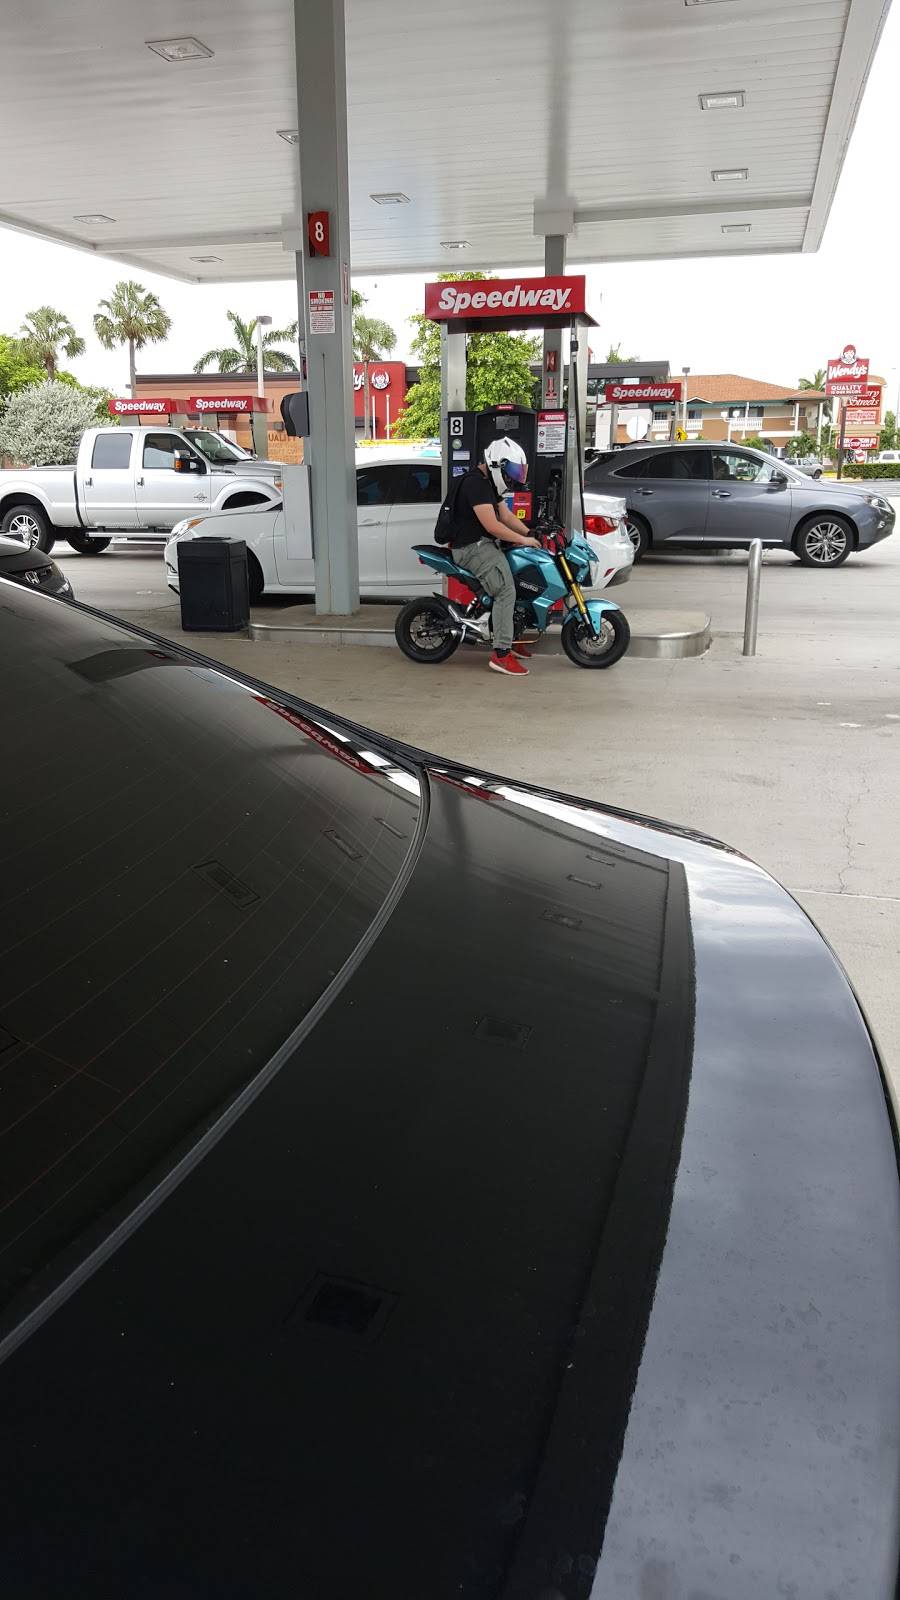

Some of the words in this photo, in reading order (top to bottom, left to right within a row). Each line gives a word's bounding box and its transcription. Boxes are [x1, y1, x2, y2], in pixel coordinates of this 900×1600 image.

[315, 221, 324, 242] 8
[439, 285, 573, 314] Speedway
[829, 364, 867, 379] Wendy's
[612, 386, 675, 399] Speedway
[115, 401, 165, 413] Speedway
[196, 398, 247, 413] Speedway
[452, 419, 461, 434] 8
